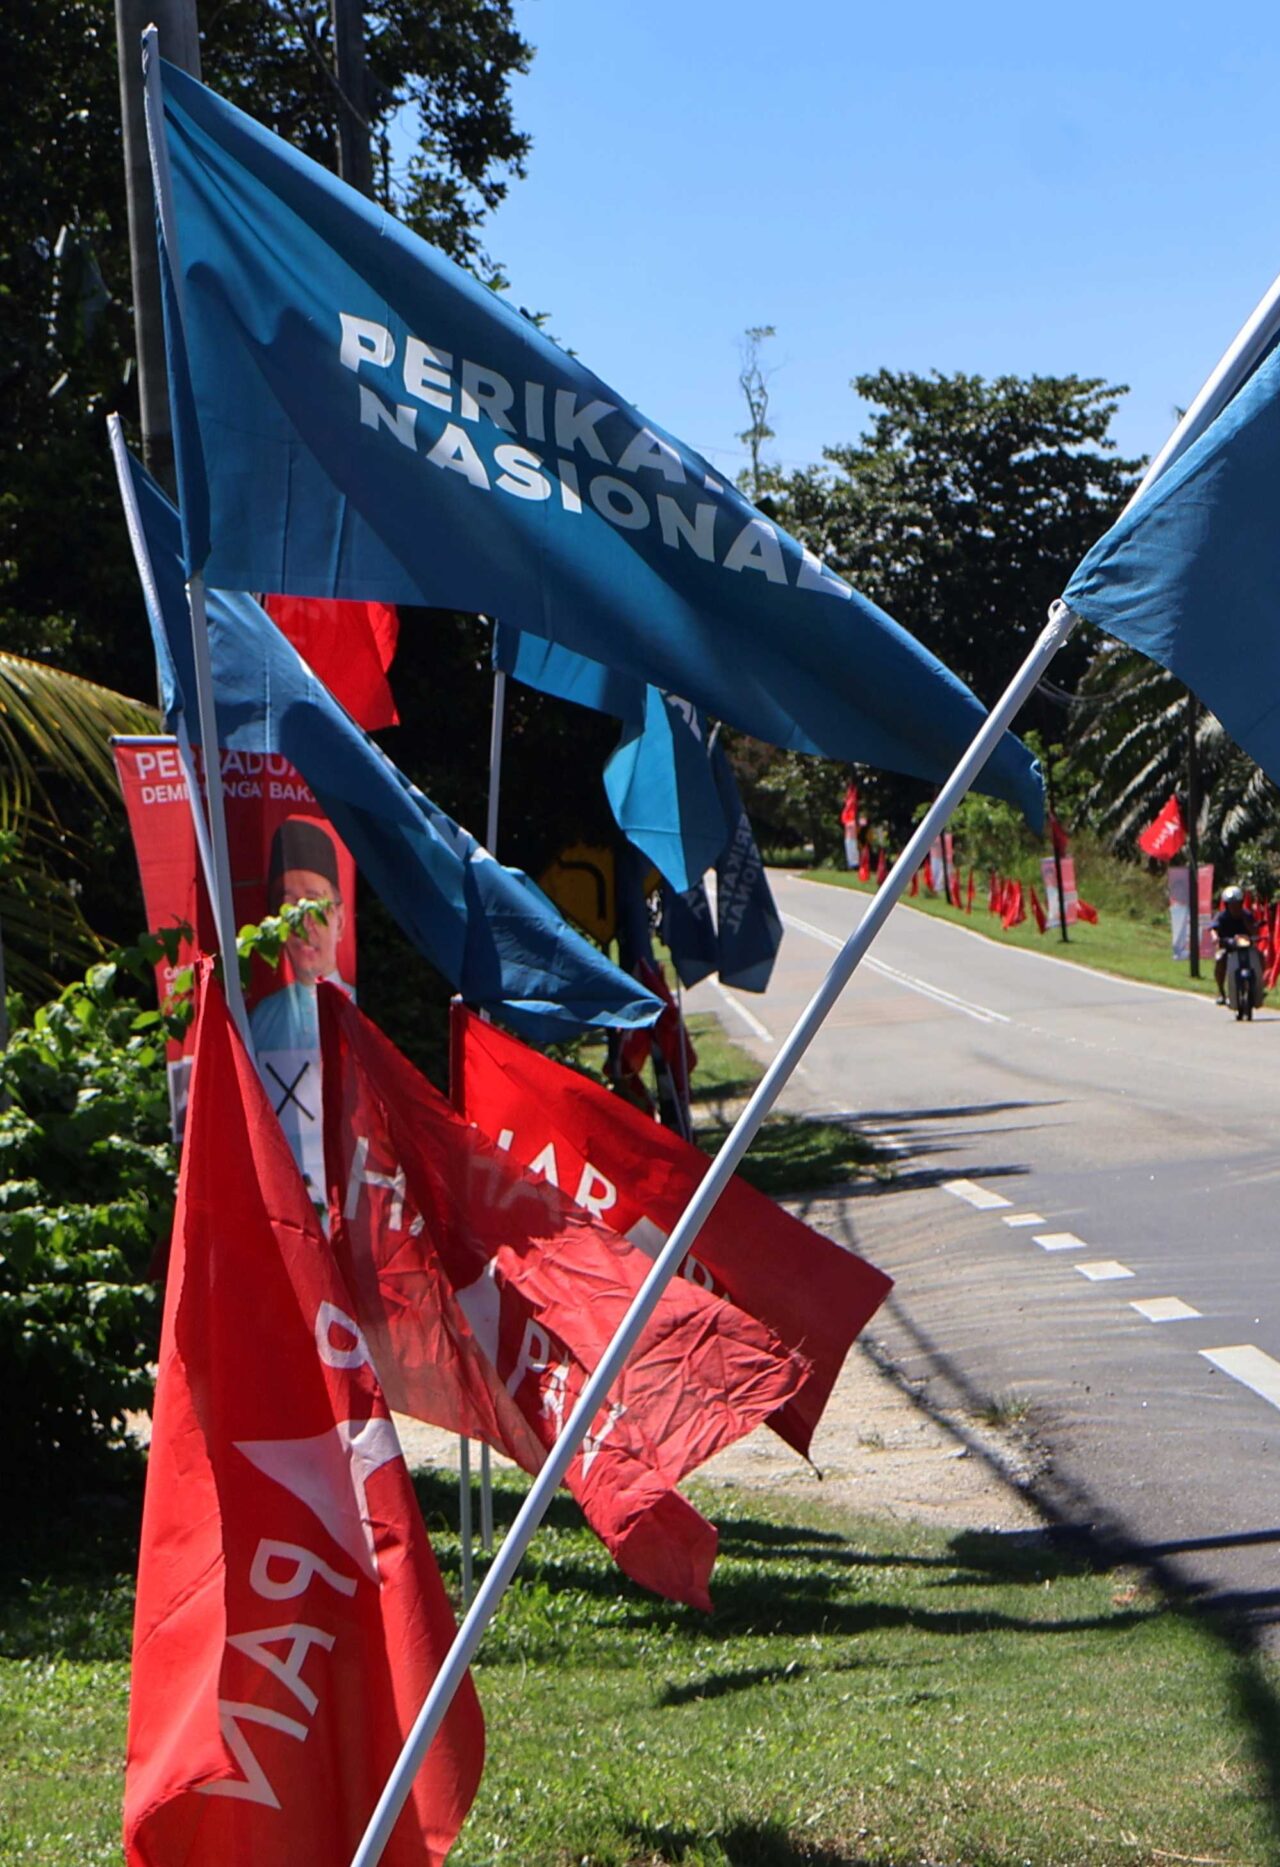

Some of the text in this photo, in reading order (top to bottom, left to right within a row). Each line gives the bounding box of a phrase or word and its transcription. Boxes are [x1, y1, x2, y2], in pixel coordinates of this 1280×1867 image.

[340, 312, 724, 493] PERIKA
[359, 384, 852, 599] NASIONAL
[269, 782, 317, 803] BAK
